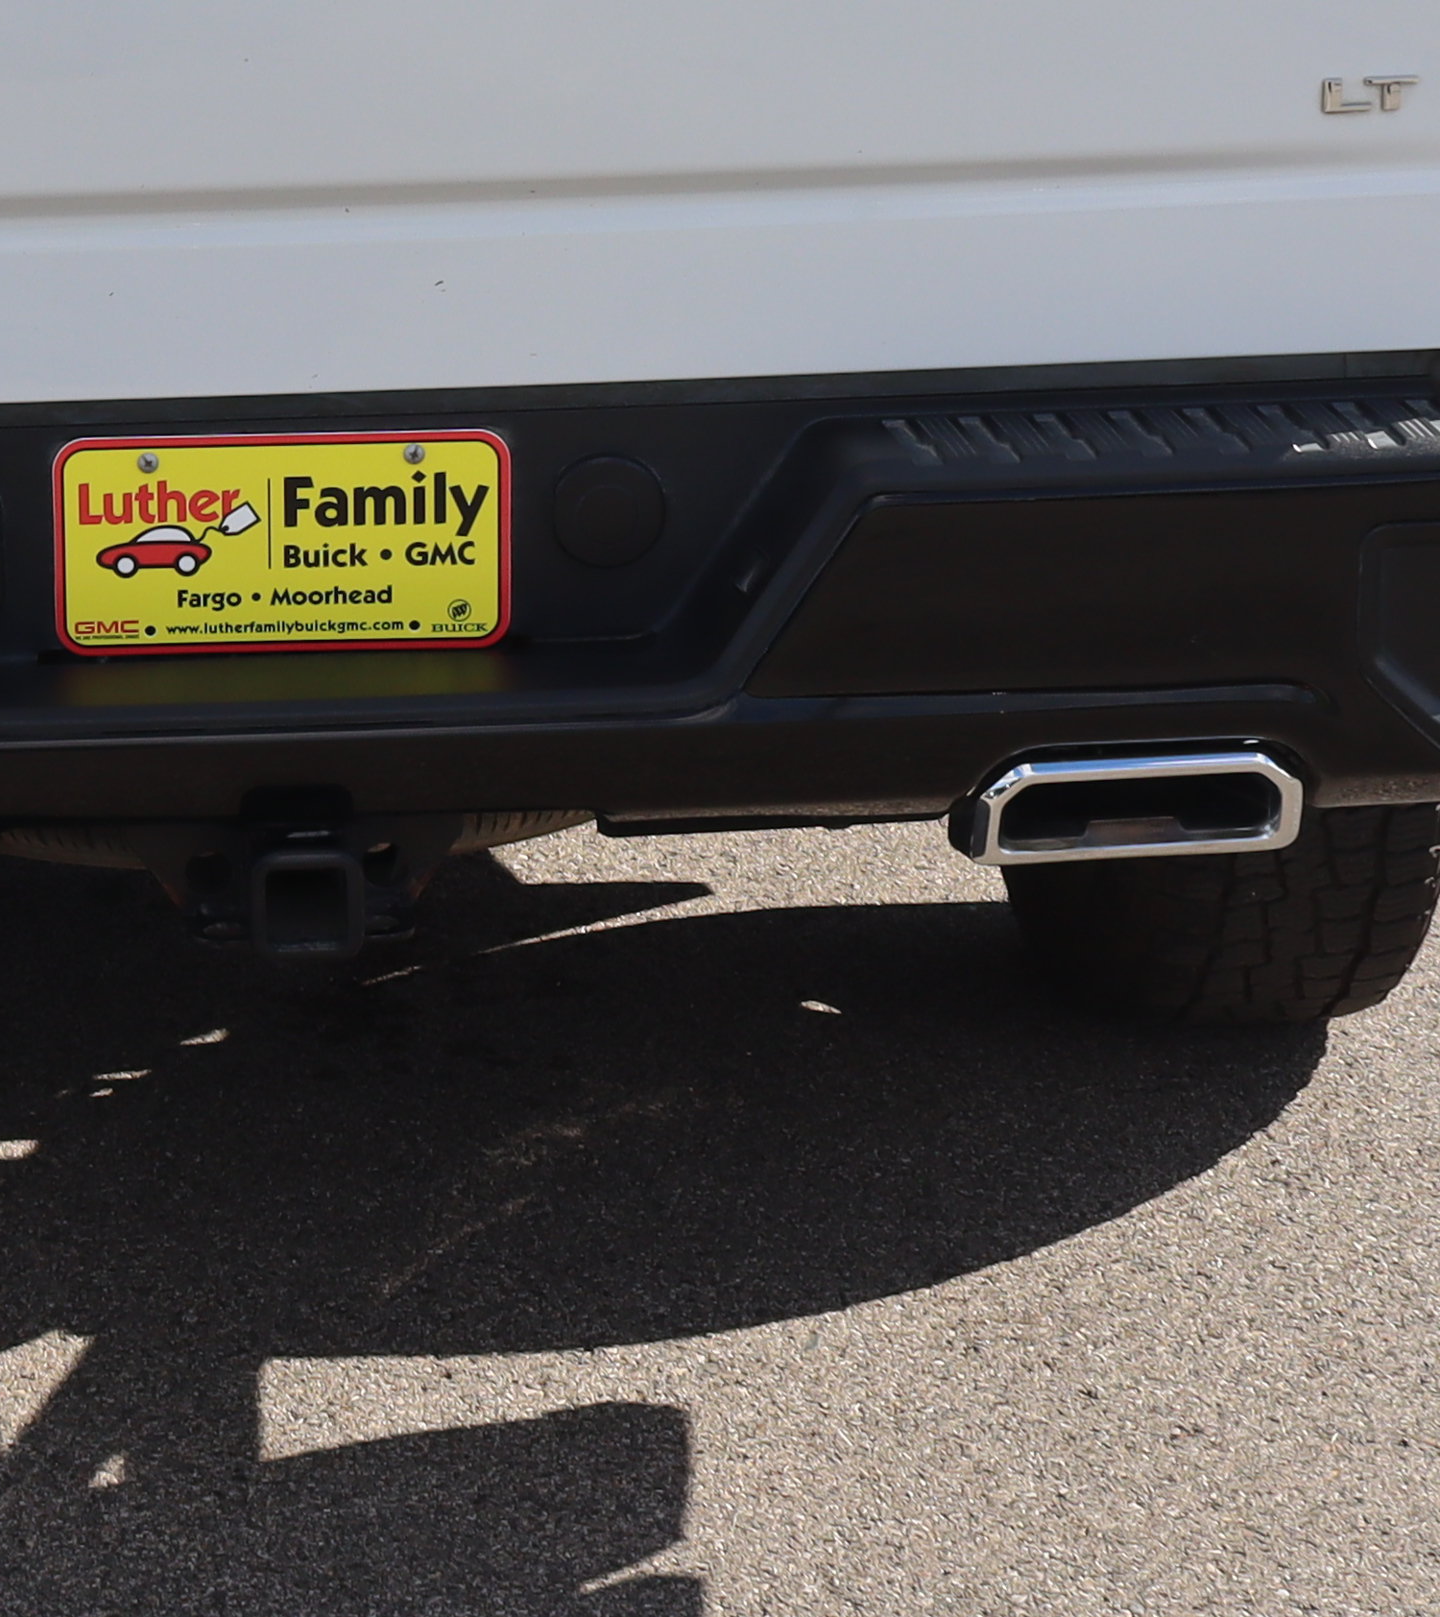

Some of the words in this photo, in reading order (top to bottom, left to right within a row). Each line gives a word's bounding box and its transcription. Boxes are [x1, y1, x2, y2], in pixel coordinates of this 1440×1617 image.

[1322, 74, 1419, 114] LT
[77, 480, 241, 526] Luther
[284, 470, 490, 537] Family
[283, 543, 369, 569] Buick
[405, 541, 477, 567] GMC
[177, 589, 243, 612] Fargo
[270, 585, 394, 606] Moorhead
[74, 620, 140, 635] GMC
[166, 617, 405, 636] www.lutherfamilybuickgmc.com
[431, 623, 488, 633] BUICK
